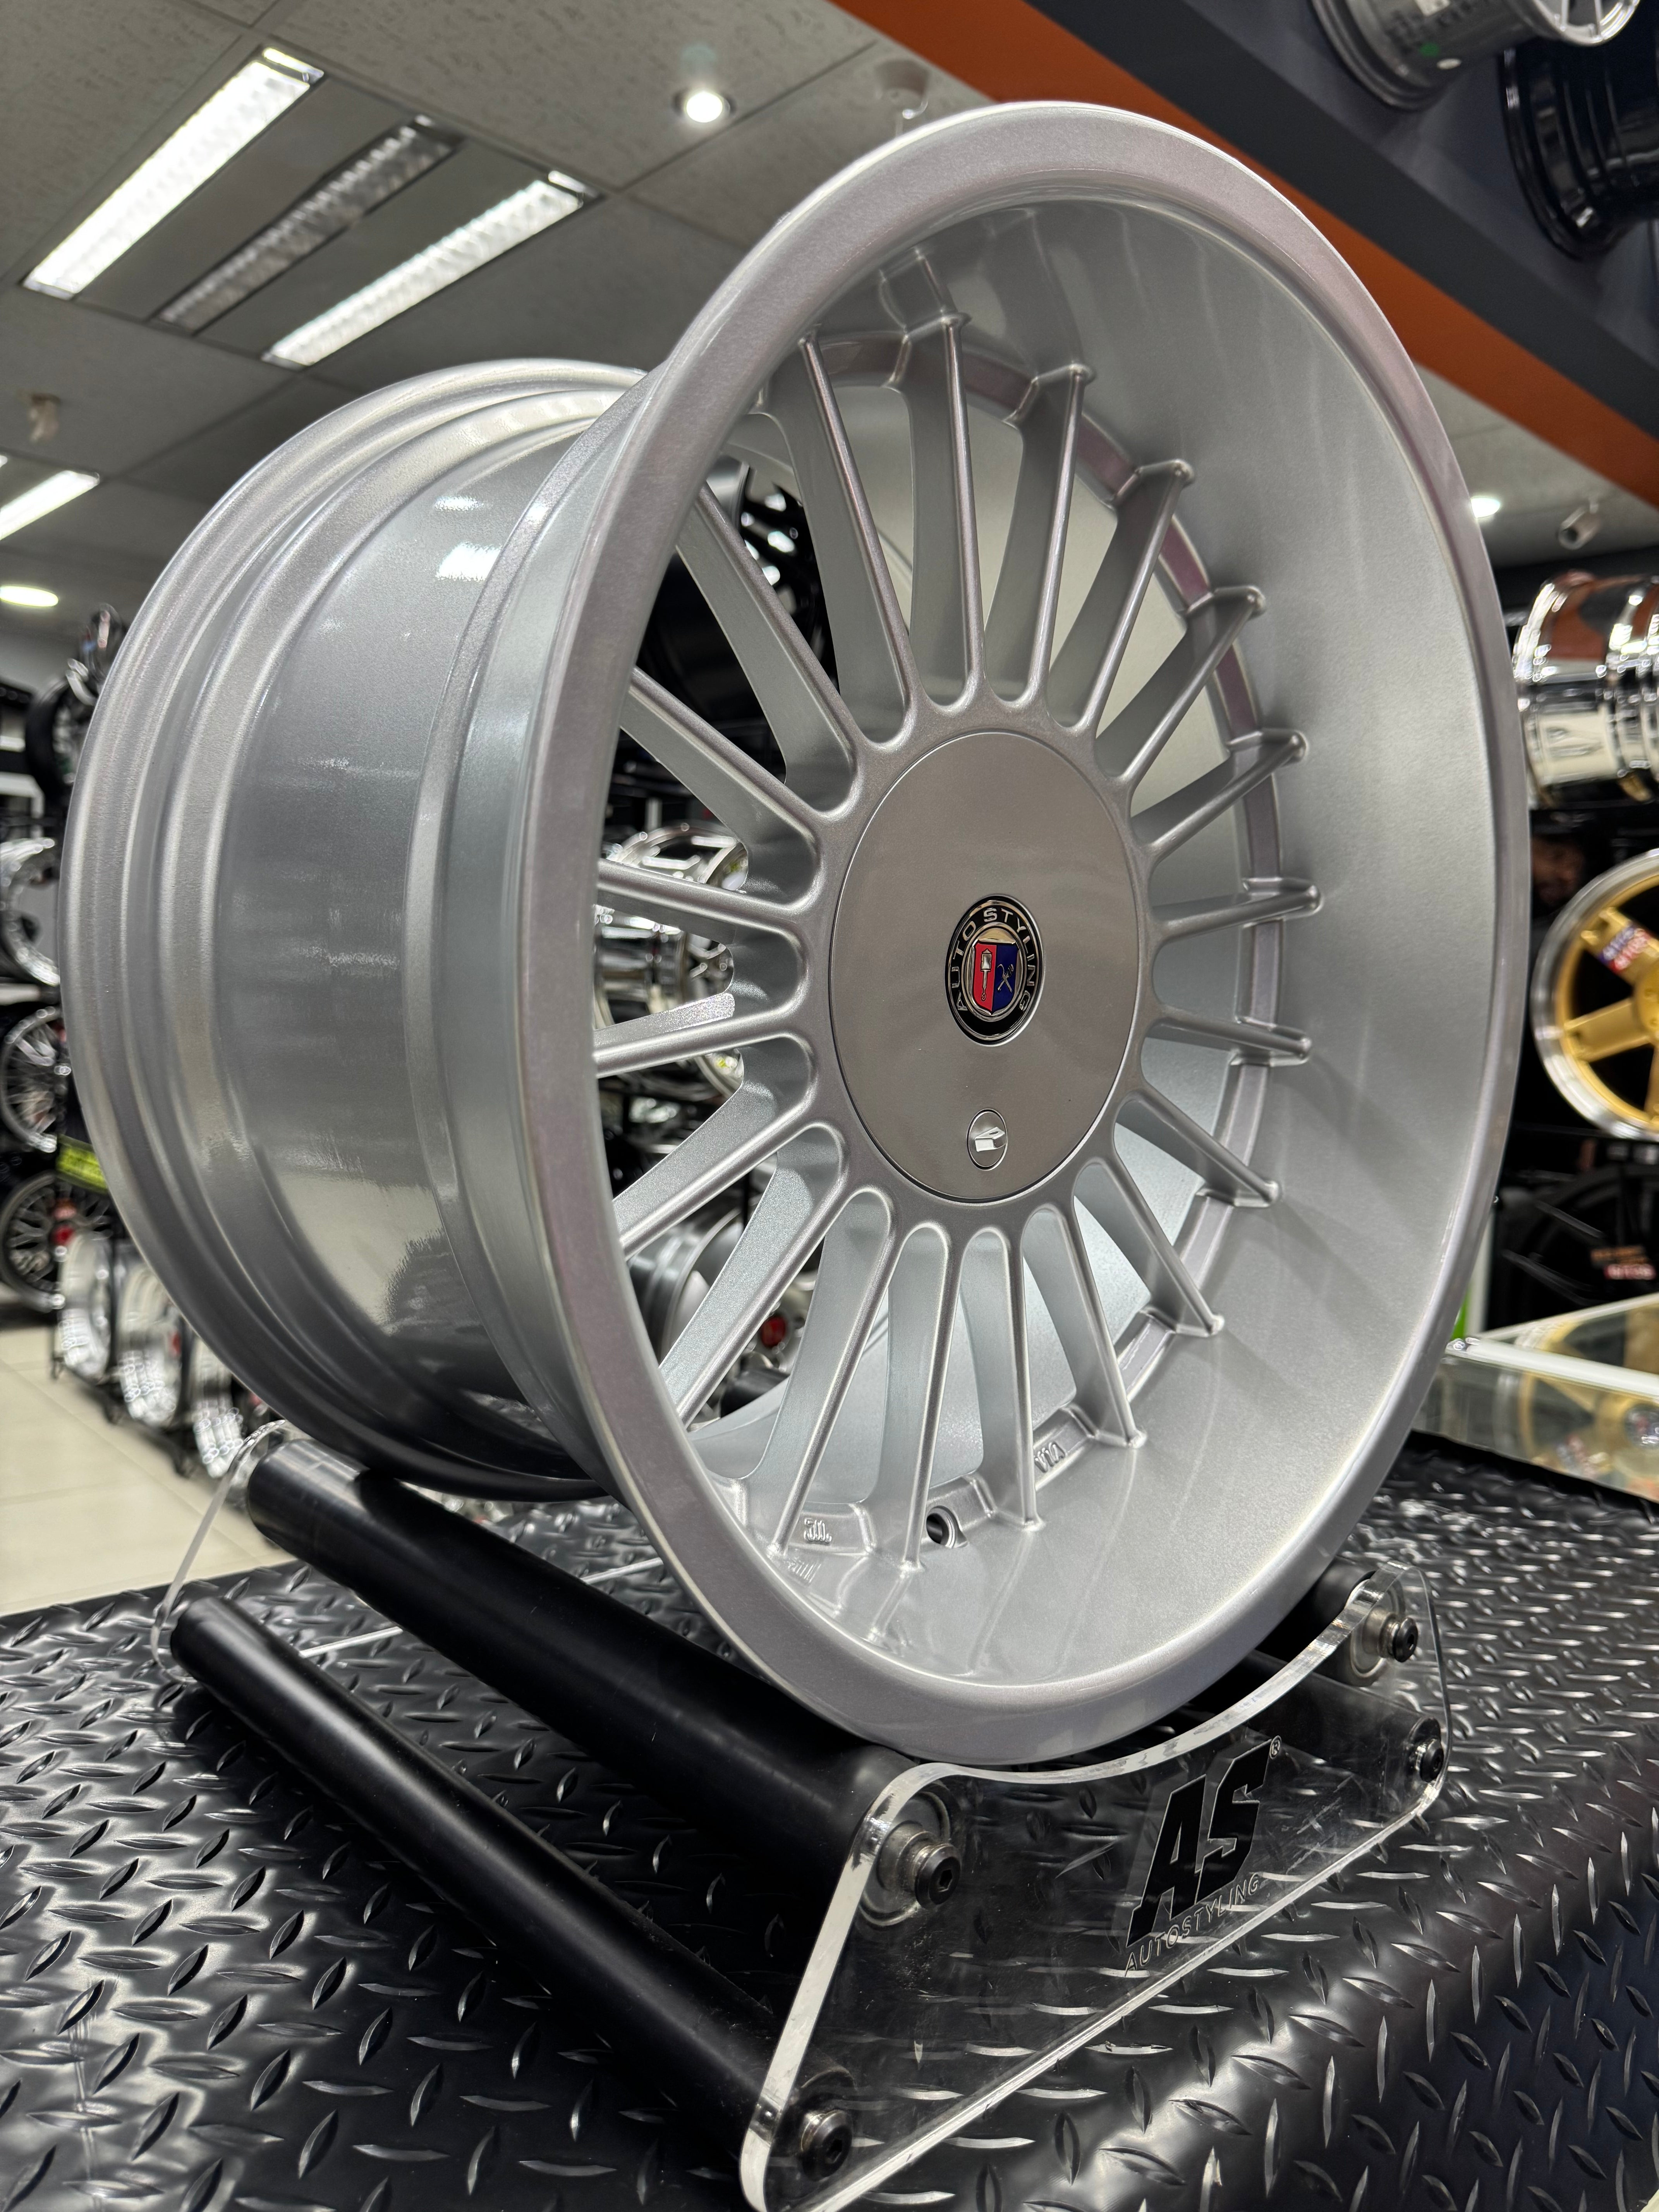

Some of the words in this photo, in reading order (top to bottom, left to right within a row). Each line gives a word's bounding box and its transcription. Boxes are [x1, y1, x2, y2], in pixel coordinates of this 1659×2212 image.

[951, 921, 975, 1011] AUTO
[984, 908, 1035, 1011] STYLING
[1125, 1872, 1259, 1977] AUTOSTYLING
